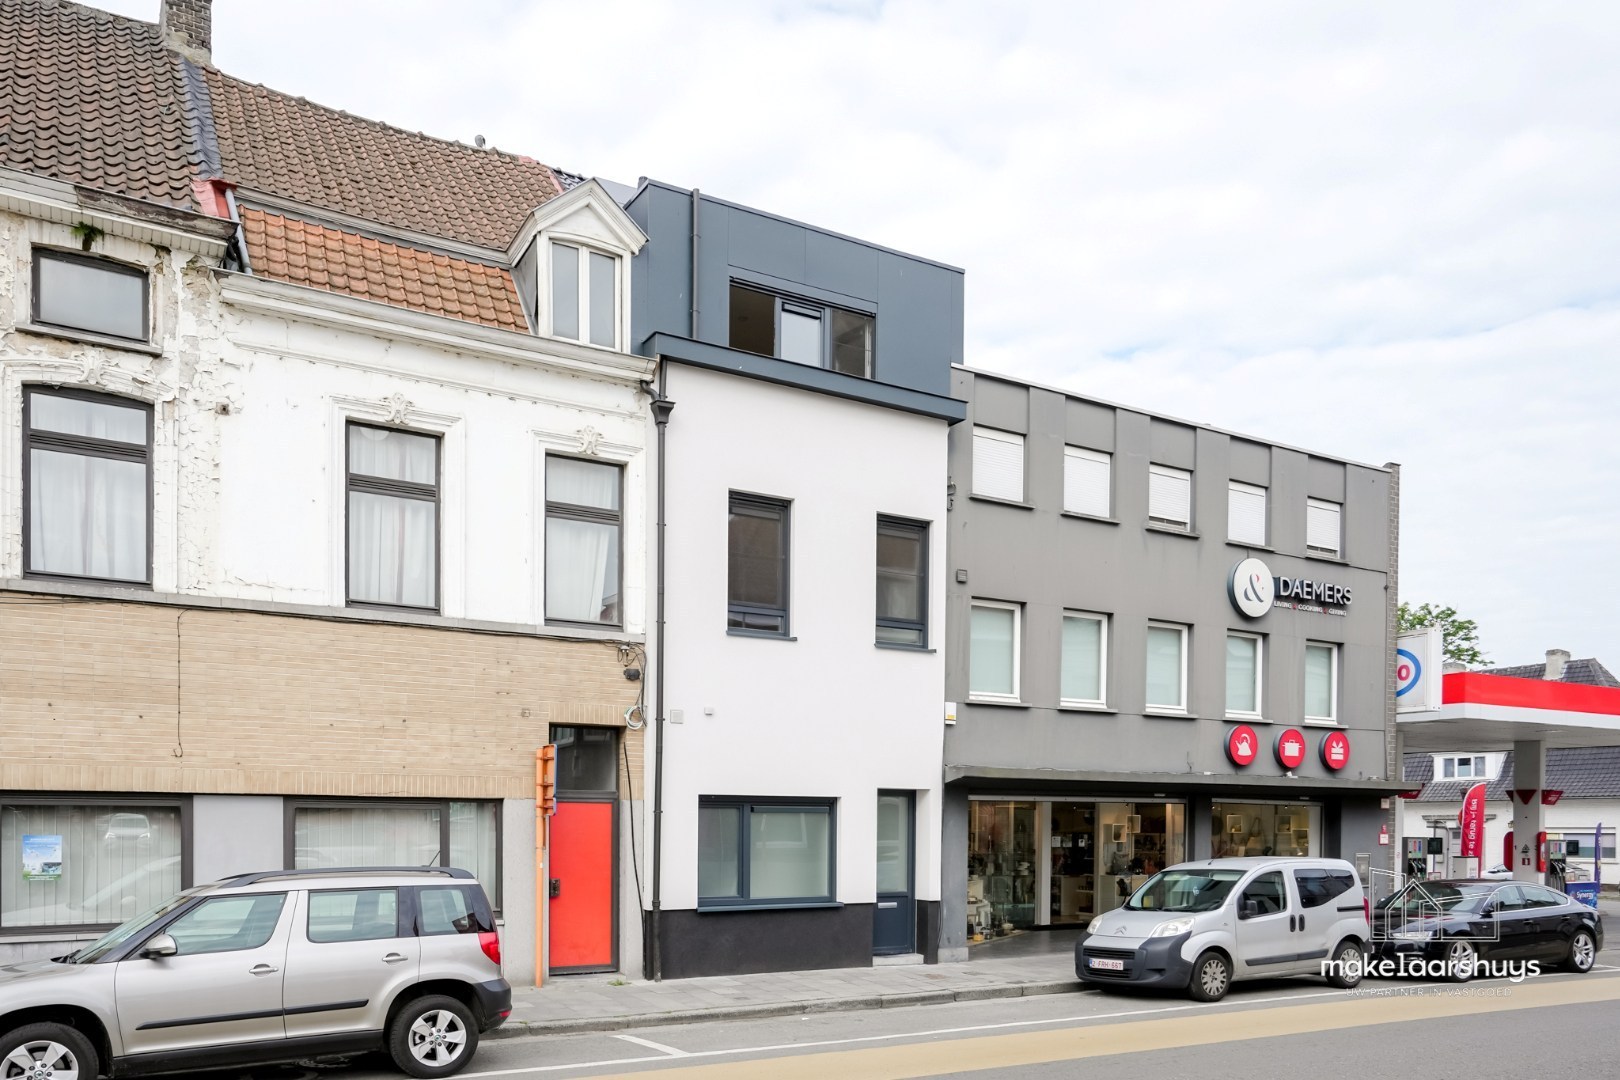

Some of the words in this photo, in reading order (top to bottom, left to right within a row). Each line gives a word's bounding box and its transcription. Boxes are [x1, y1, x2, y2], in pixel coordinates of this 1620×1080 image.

[1279, 576, 1353, 605] DAEMERS
[1273, 600, 1292, 609] LIVING
[1297, 603, 1323, 613] COOKING
[1328, 607, 1347, 617] GIVING
[1468, 820, 1476, 840] terug
[1576, 891, 1594, 900] Synergy
